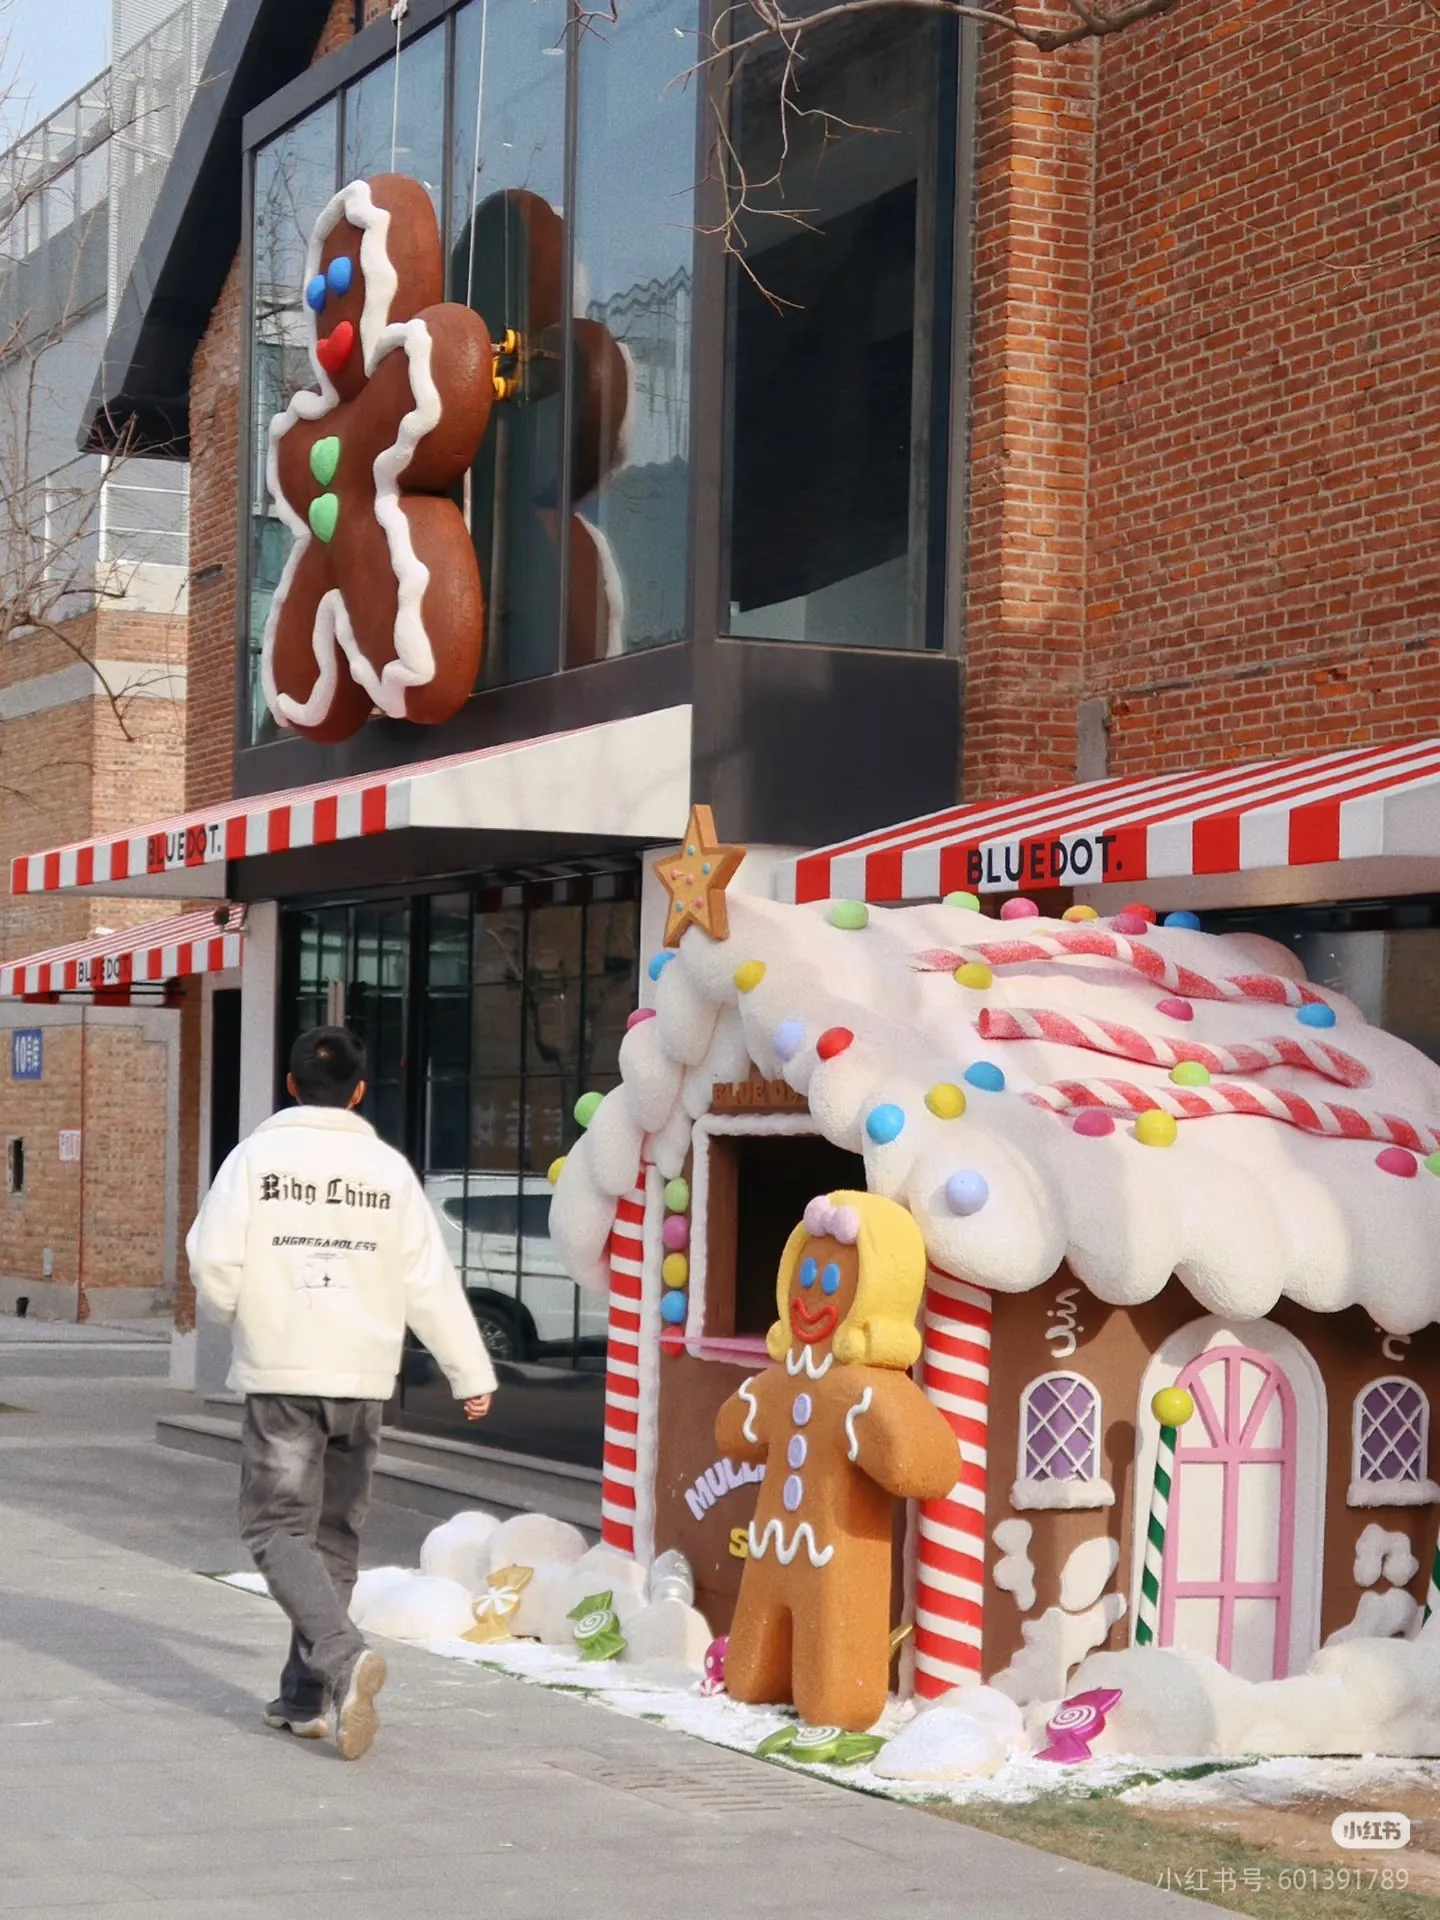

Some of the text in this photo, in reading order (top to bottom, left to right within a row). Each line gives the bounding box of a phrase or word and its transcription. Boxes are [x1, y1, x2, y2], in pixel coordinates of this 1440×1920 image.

[148, 824, 221, 866] BLUEDOT.
[967, 835, 1123, 884] BLUEDOT.
[325, 1178, 392, 1210] China
